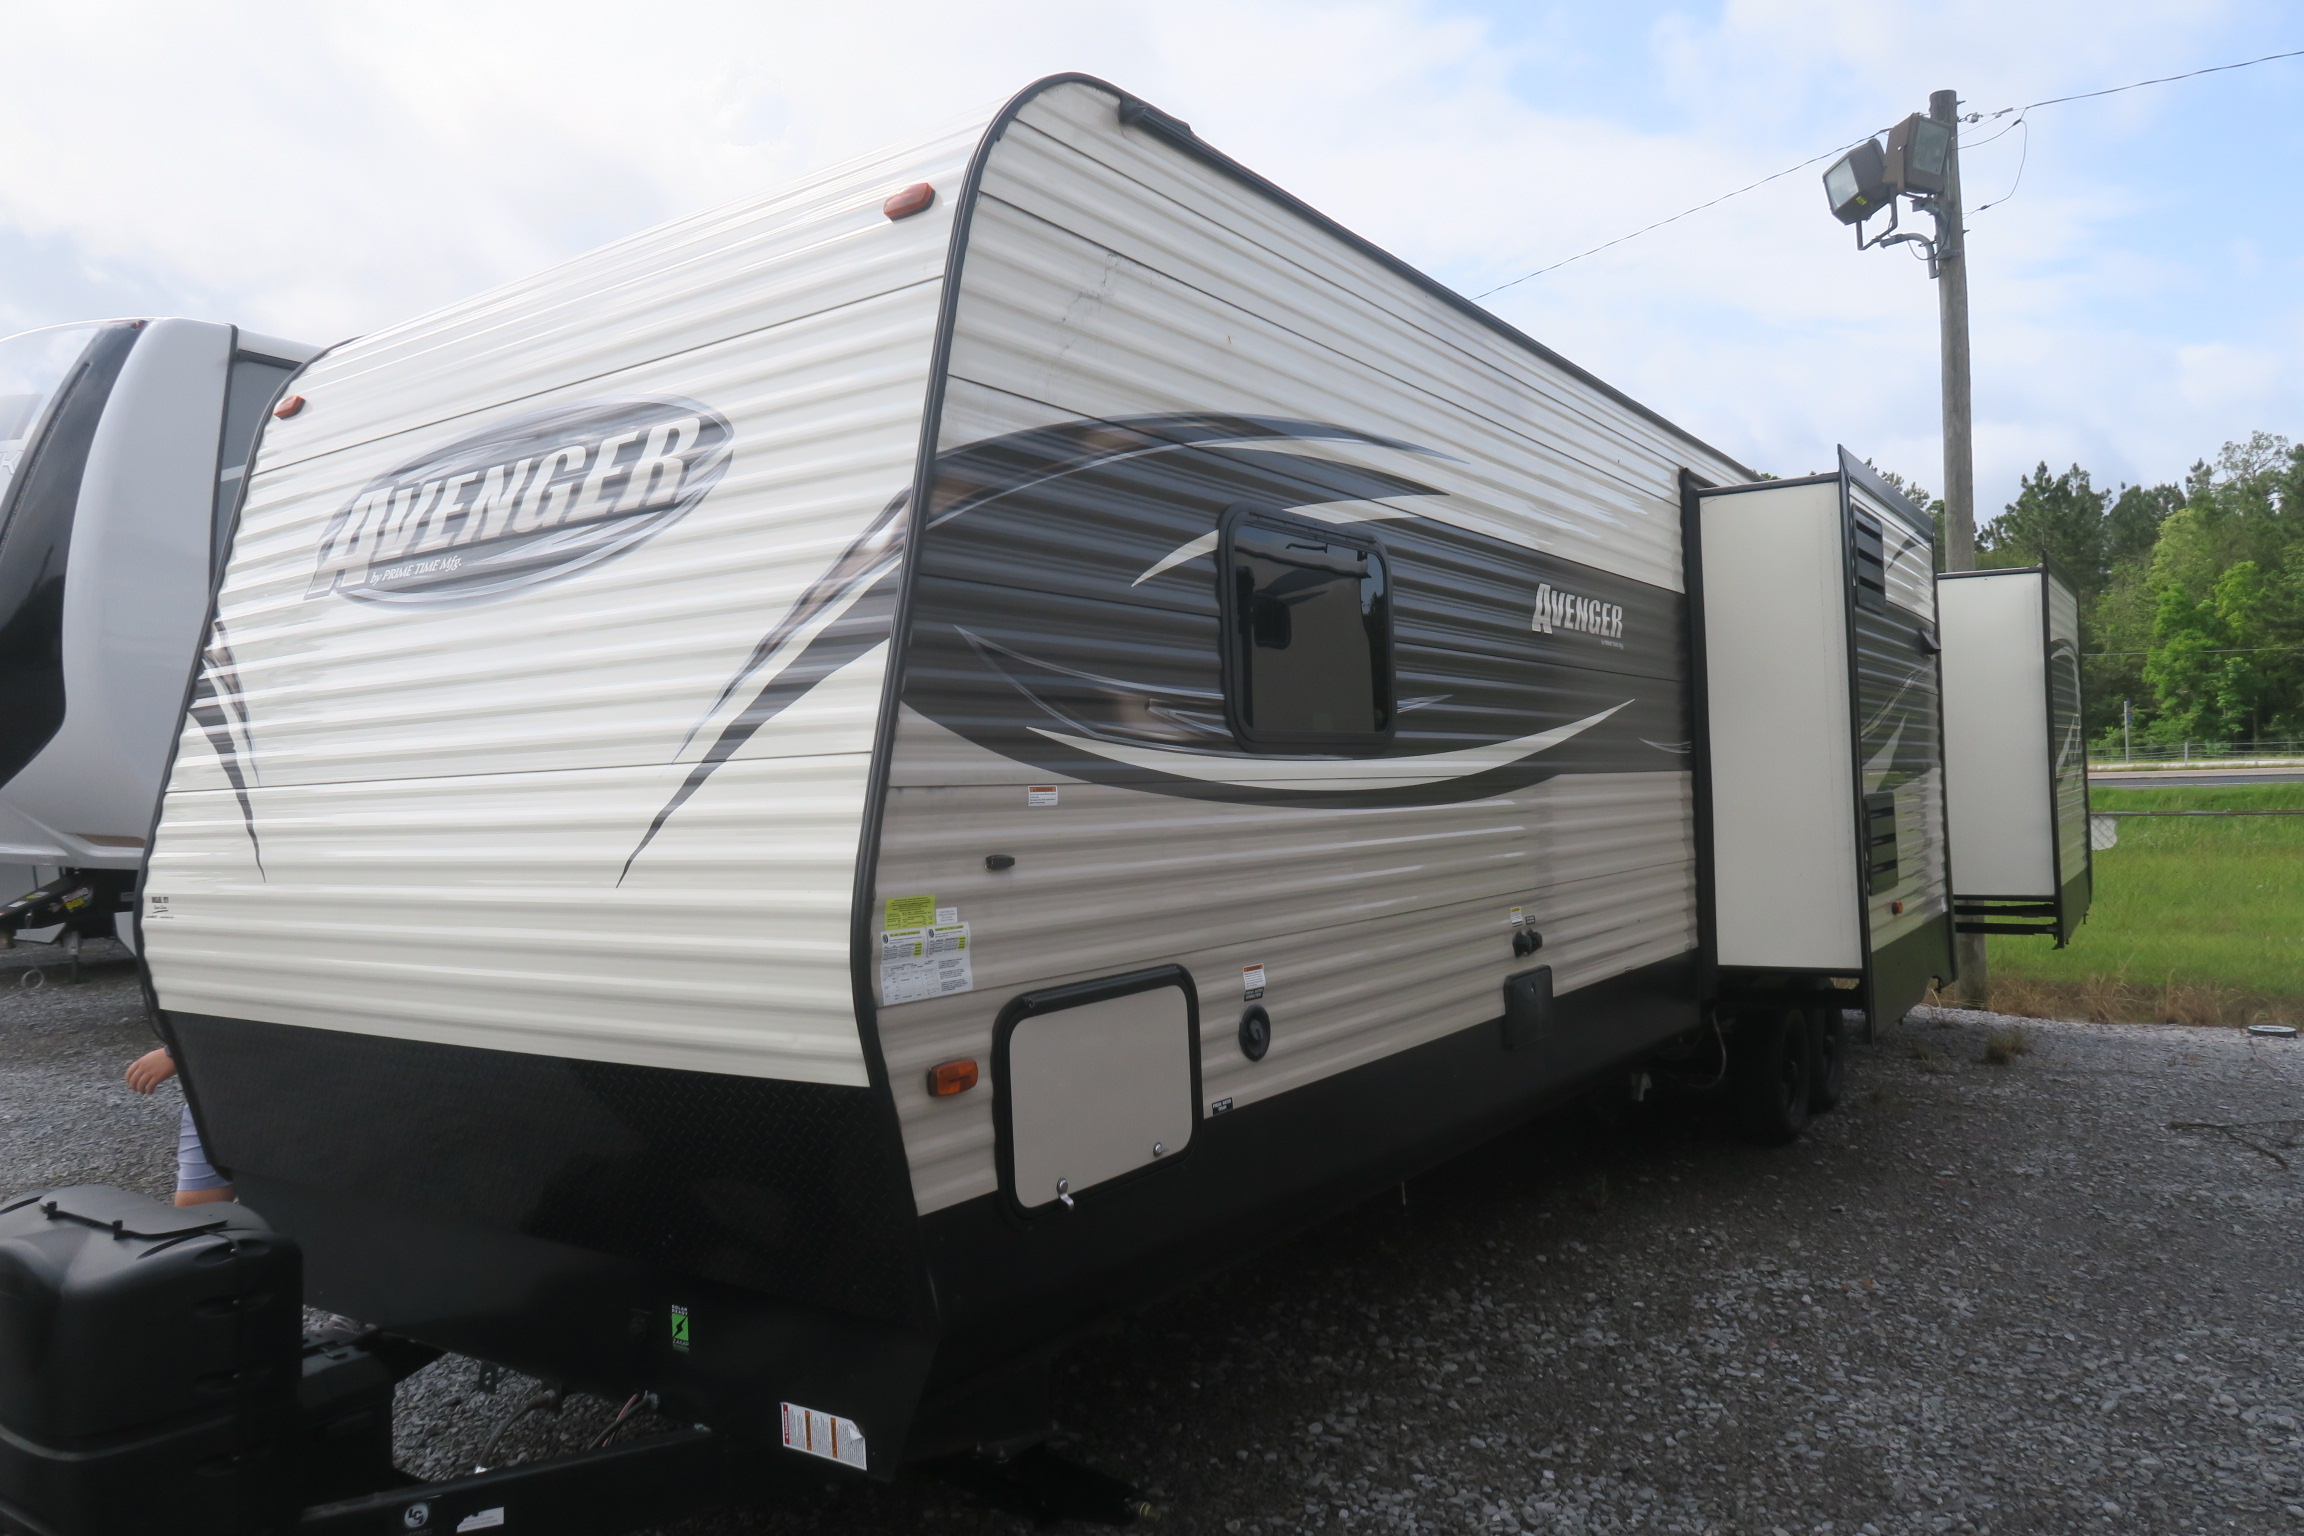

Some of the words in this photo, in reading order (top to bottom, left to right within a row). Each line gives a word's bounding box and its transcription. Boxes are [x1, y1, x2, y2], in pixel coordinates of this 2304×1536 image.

[304, 417, 702, 600] AVENGER
[369, 571, 383, 586] by
[382, 564, 415, 581] PRIME
[414, 559, 441, 575] TIME
[439, 554, 462, 572] Mfg.
[1531, 582, 1623, 639] AVENGER
[671, 1304, 688, 1312] SOLAR
[671, 1308, 688, 1316] READY
